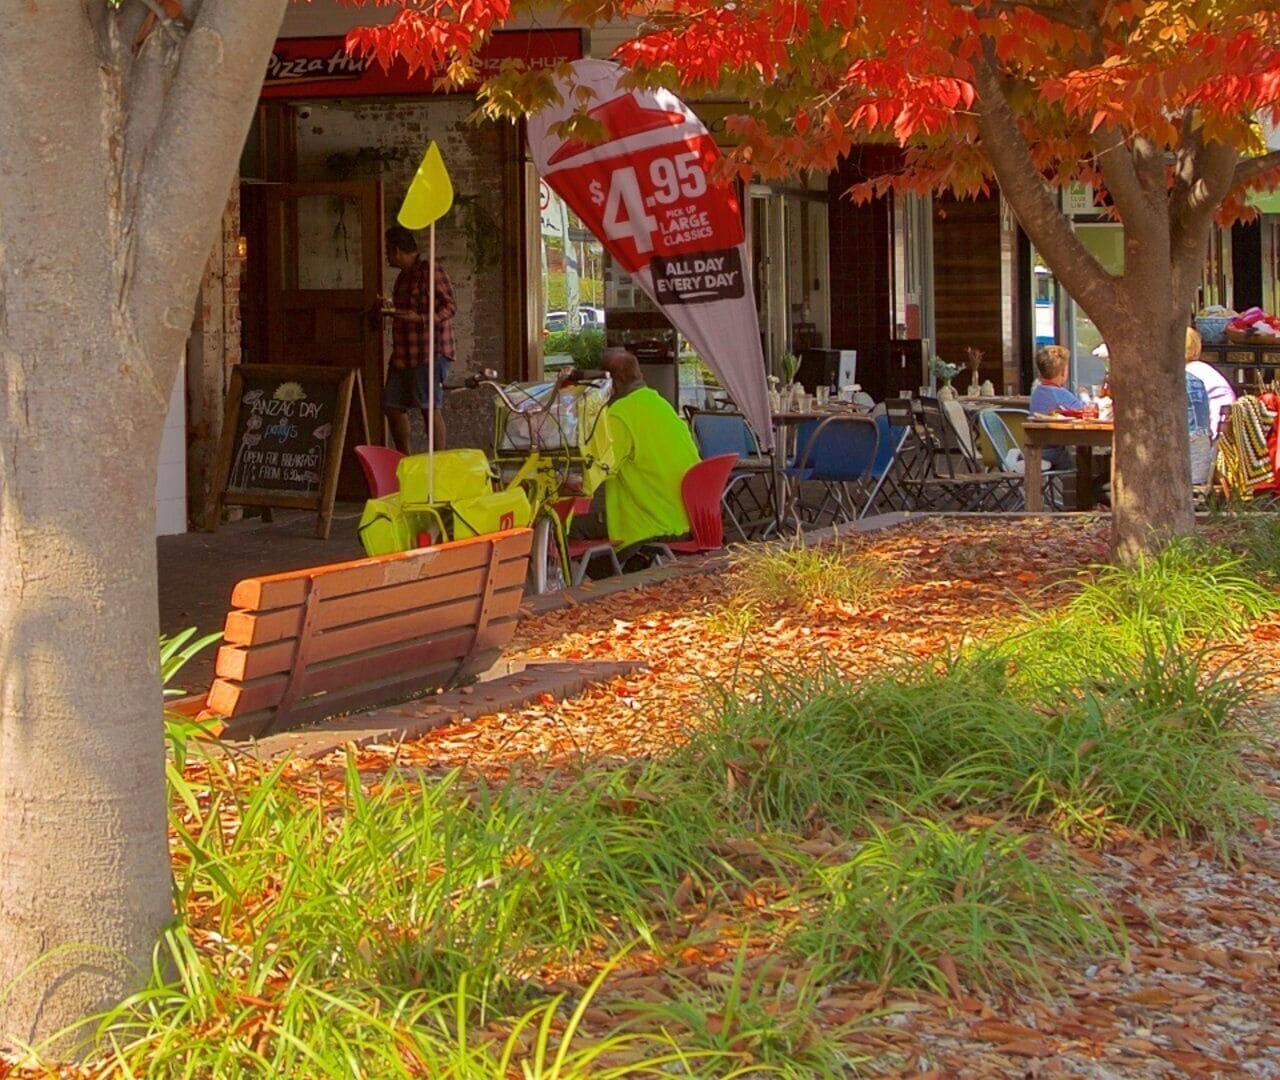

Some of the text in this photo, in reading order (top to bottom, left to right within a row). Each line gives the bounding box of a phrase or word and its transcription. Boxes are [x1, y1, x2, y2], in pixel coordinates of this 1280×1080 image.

[665, 205, 697, 218] PICK UP
[660, 210, 710, 234] LARGE
[663, 226, 714, 246] CLASSICS
[665, 256, 725, 276] ALL DAY
[656, 274, 703, 293] EVERY
[250, 399, 324, 419] ANZAC DAY
